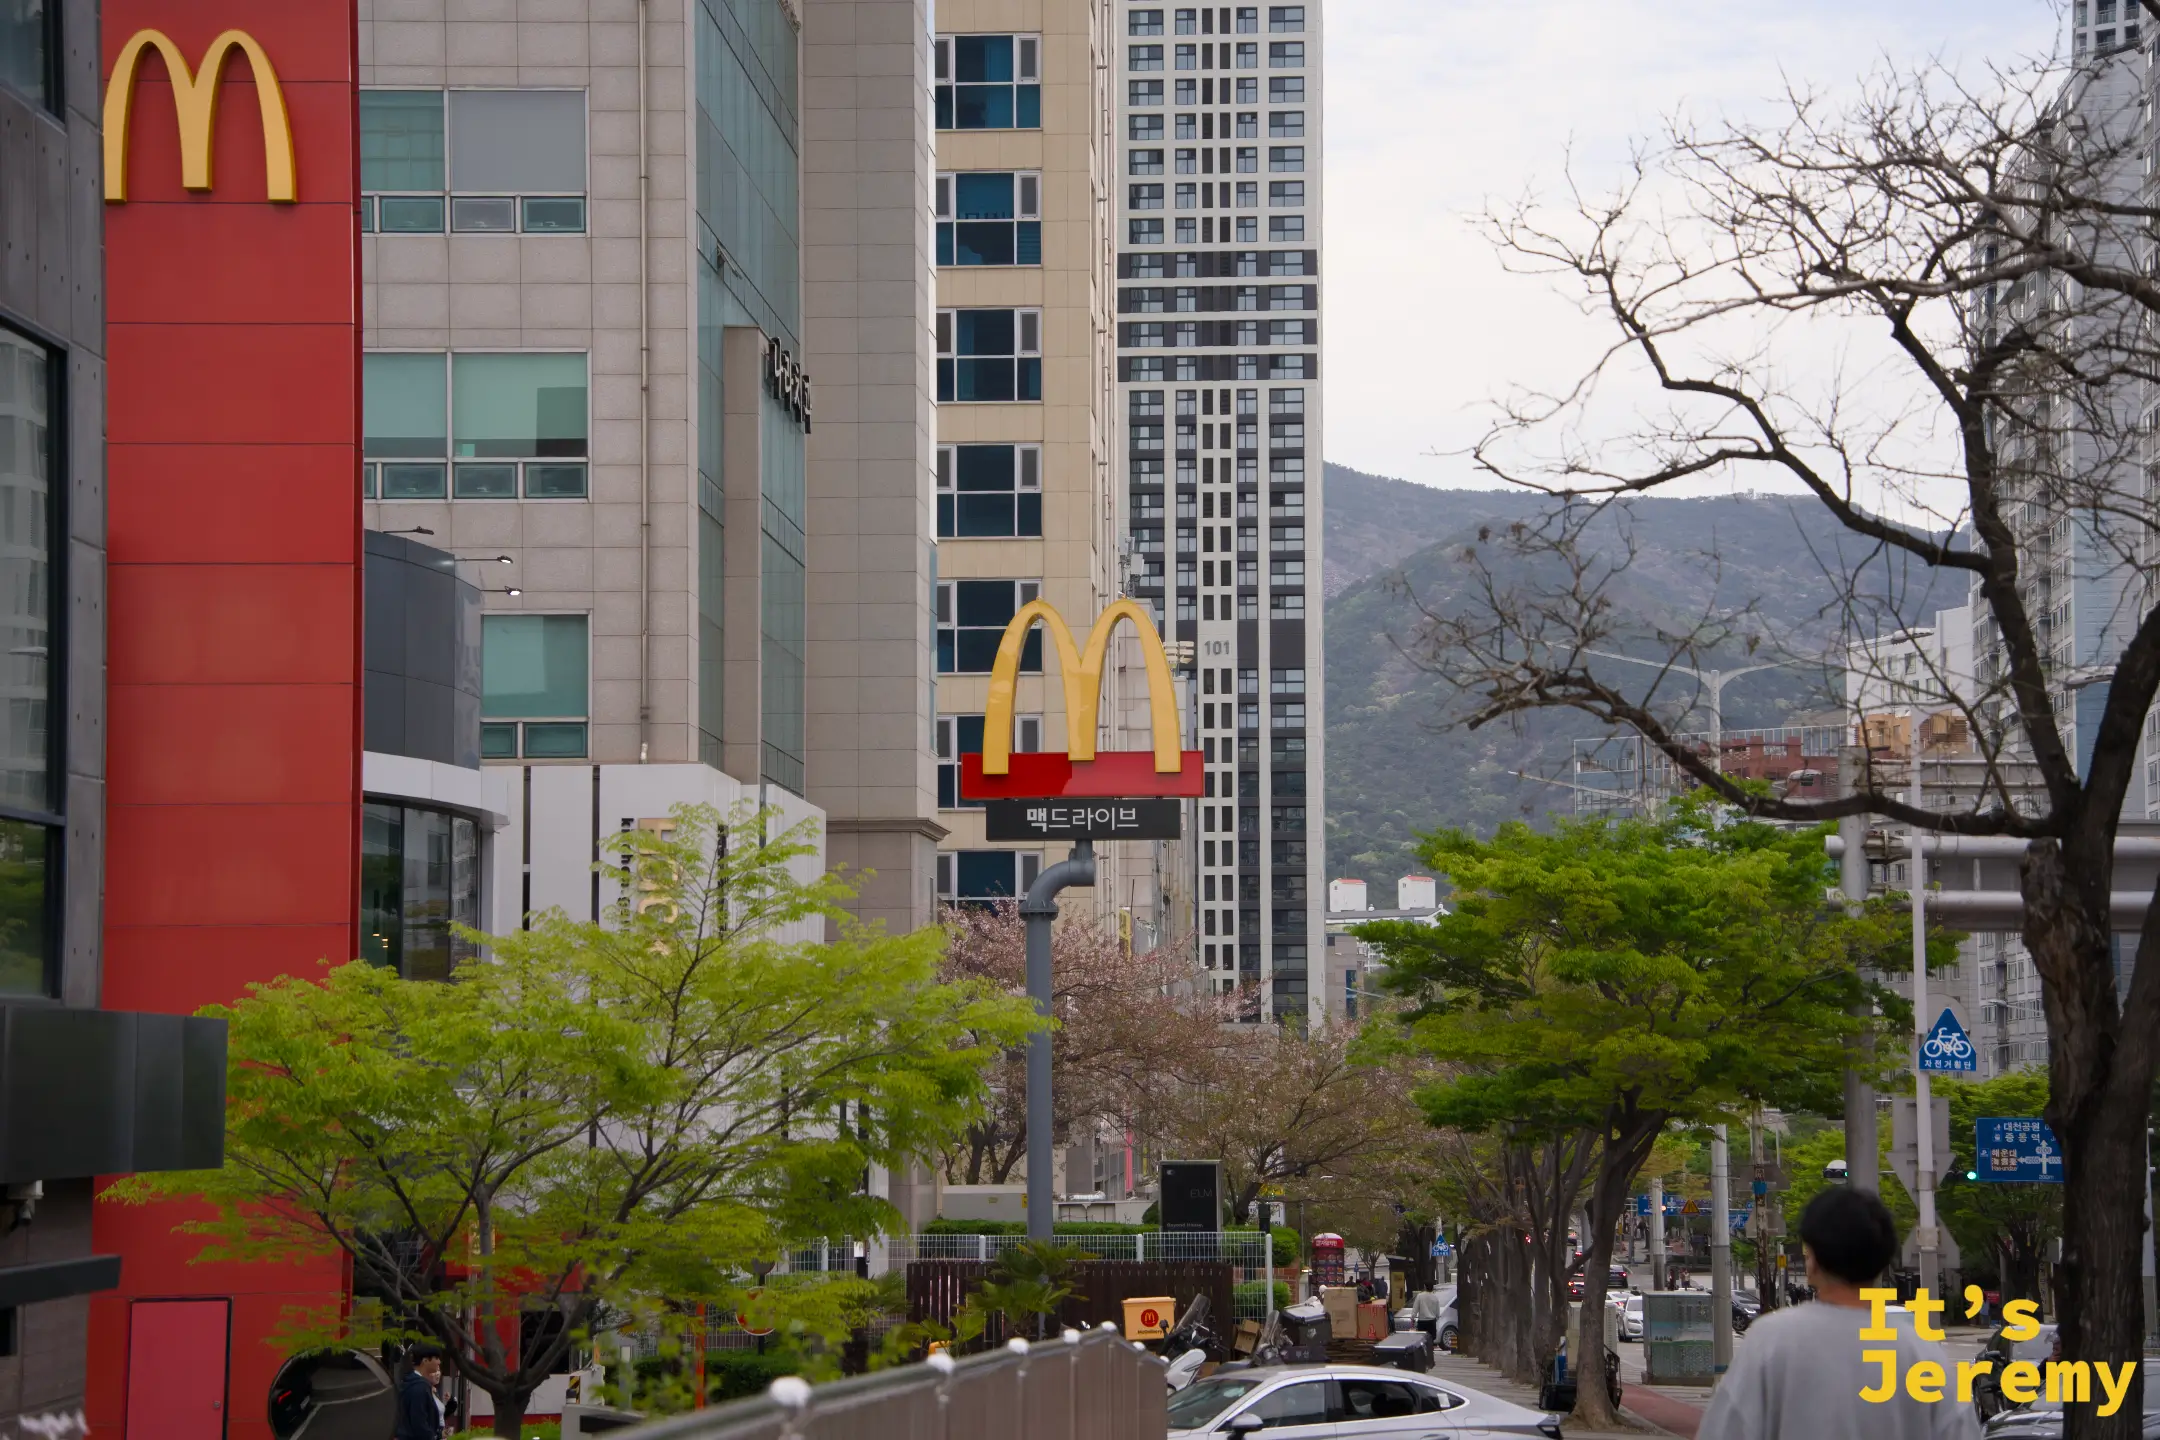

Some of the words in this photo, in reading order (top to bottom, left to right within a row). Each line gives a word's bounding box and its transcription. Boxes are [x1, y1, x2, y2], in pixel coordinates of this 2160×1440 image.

[1204, 640, 1230, 656] 101
[1026, 807, 1139, 832] 맥드라이브
[1924, 1059, 1971, 1069] 자전거횡단
[2003, 1122, 2040, 1132] 대천공원
[1991, 1149, 2017, 1157] 해운대
